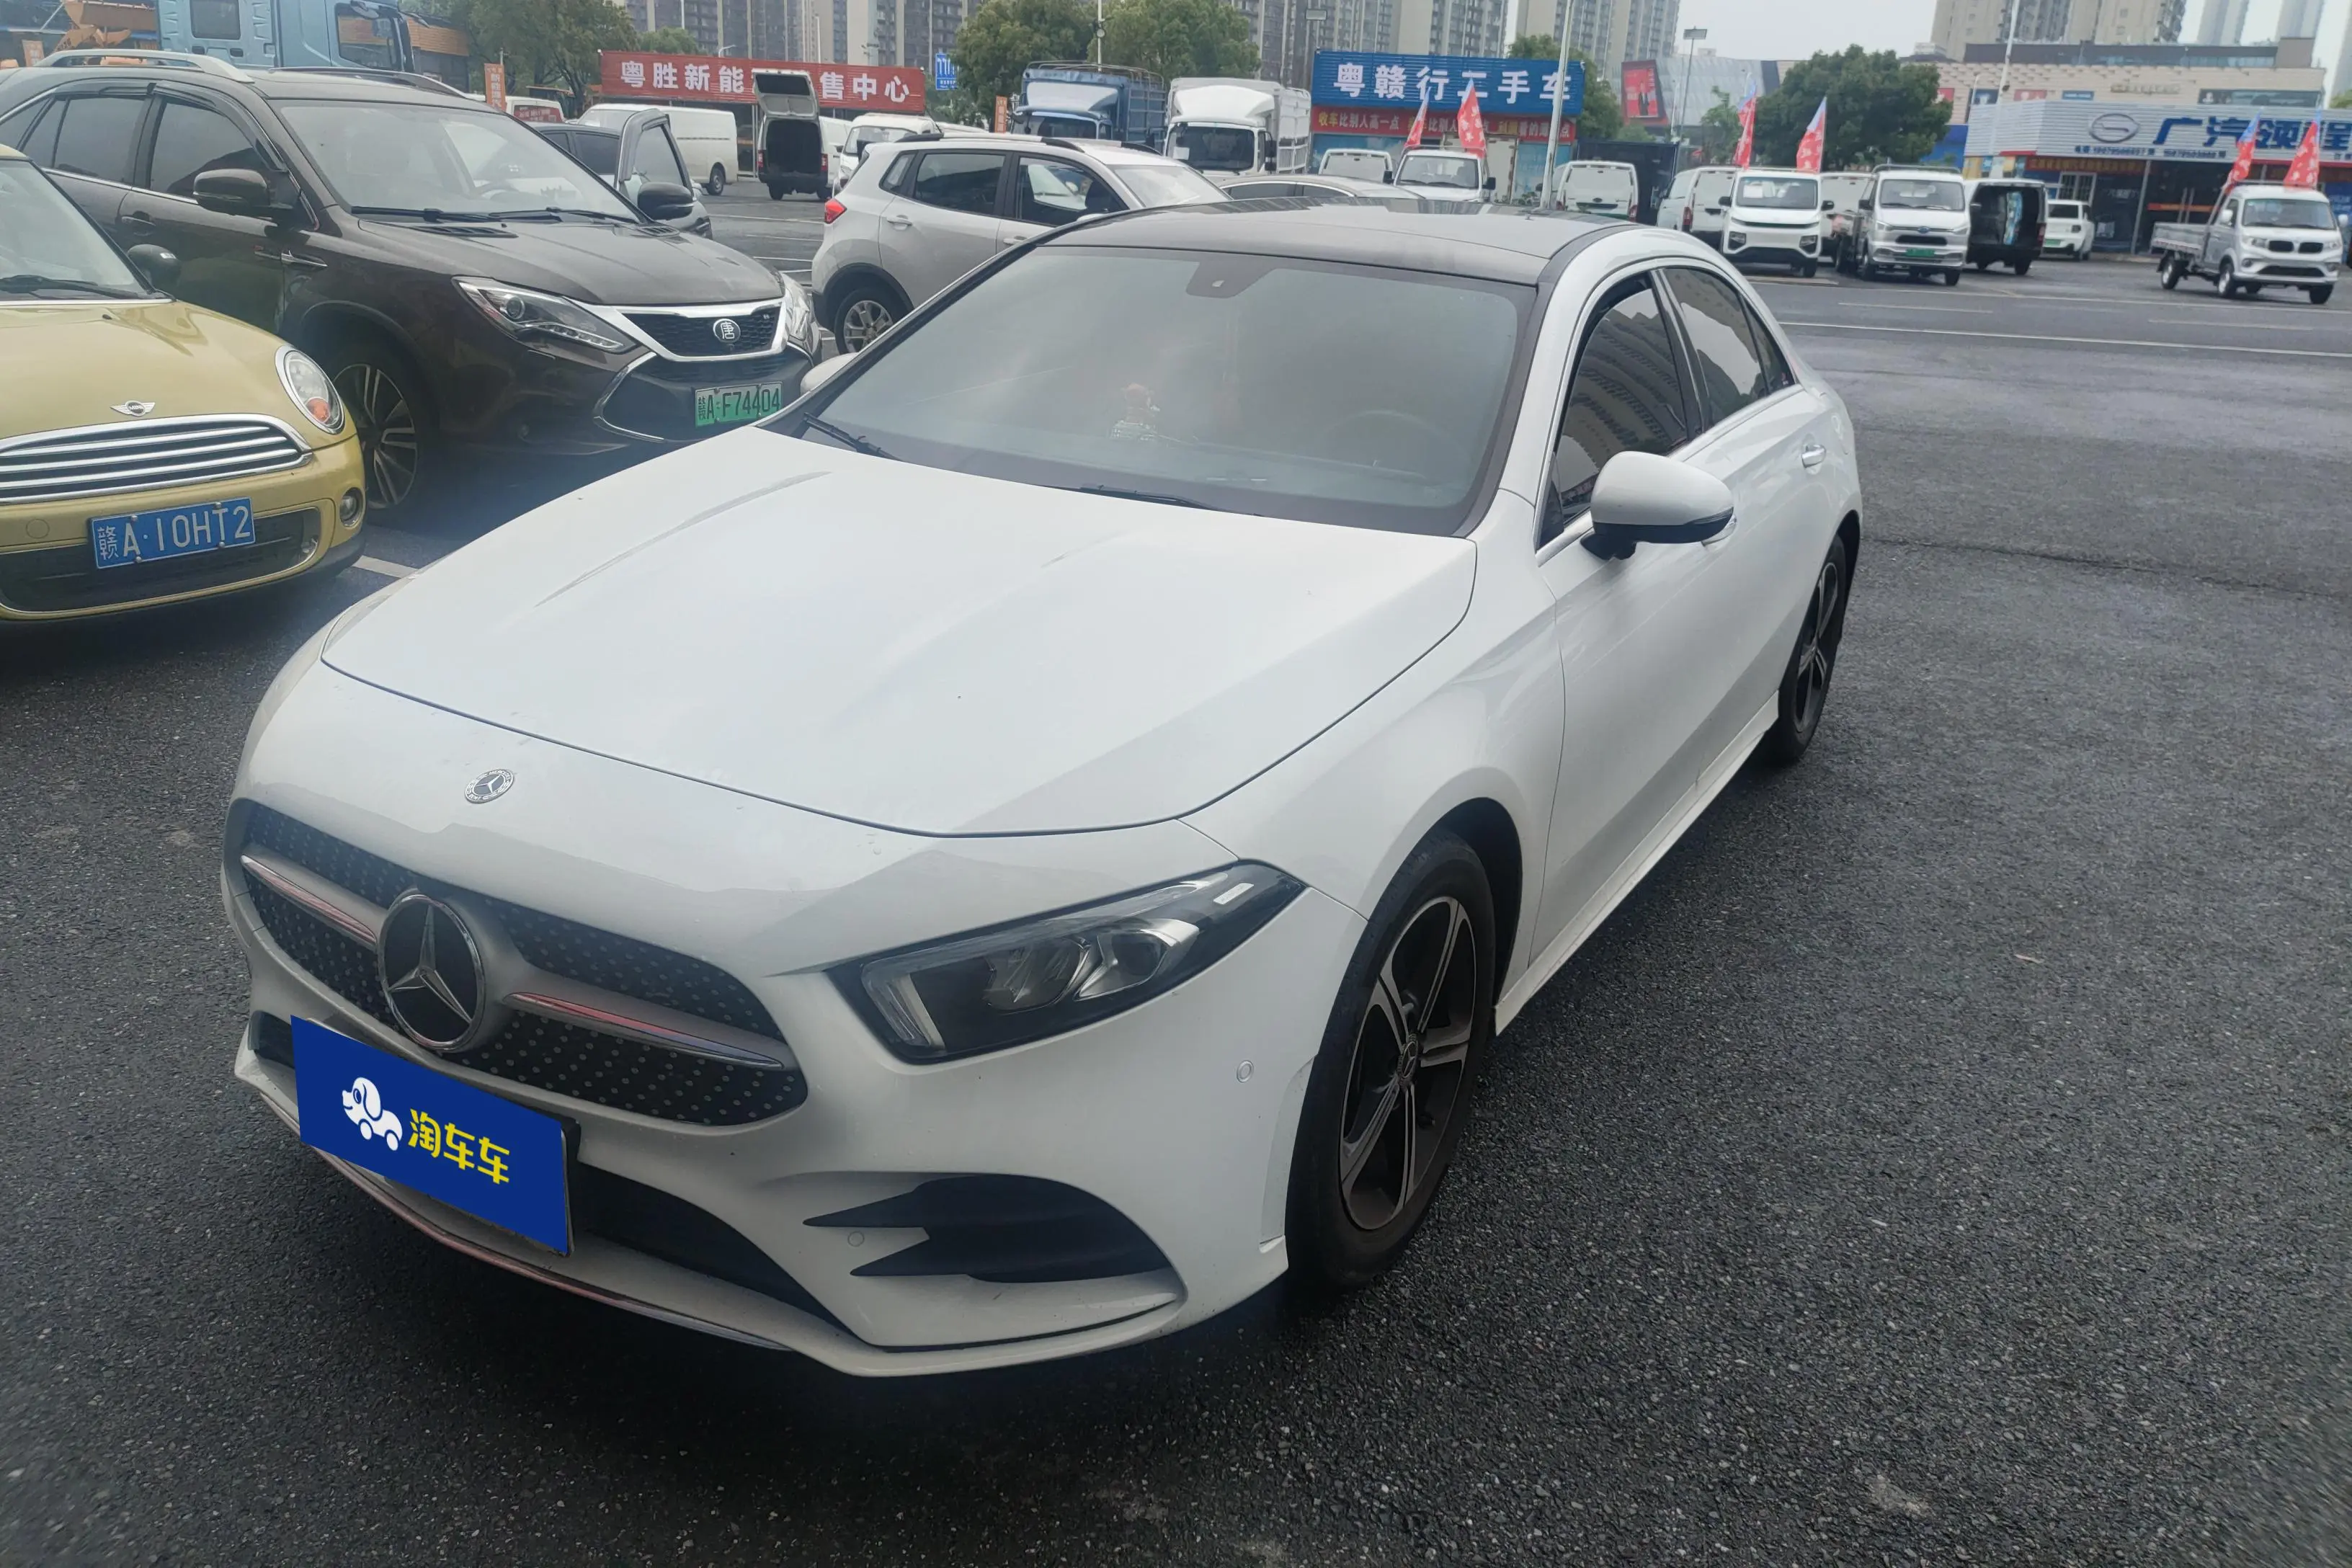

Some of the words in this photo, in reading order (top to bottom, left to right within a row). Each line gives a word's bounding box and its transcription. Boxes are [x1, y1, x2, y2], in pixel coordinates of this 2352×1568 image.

[620, 61, 909, 102] 粤胜新能售中心
[1333, 63, 1572, 104] 粤赣行二手车
[1319, 111, 1399, 130] 收车比别人高一点
[721, 321, 736, 339] 唐
